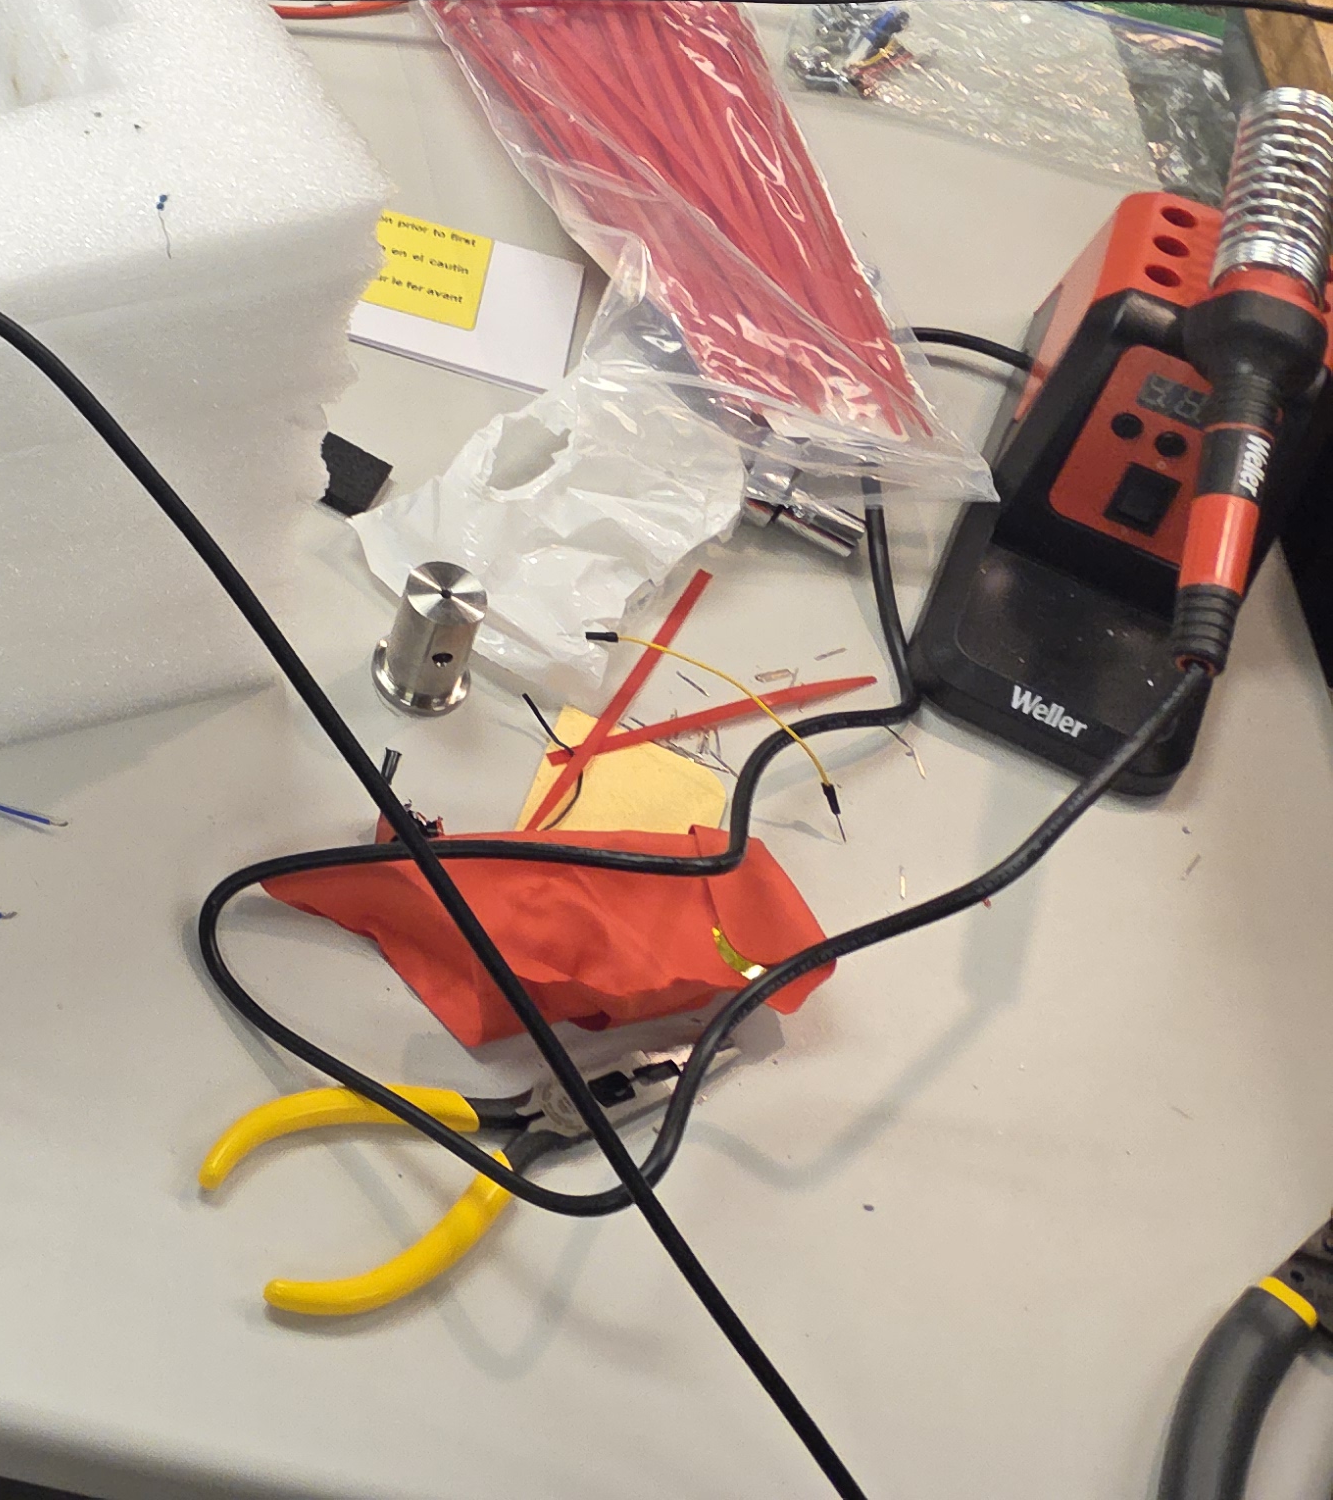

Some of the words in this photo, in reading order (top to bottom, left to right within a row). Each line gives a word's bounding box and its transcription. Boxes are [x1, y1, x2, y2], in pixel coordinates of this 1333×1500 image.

[397, 219, 429, 234] prior
[432, 228, 446, 239] to
[450, 232, 477, 247] first
[390, 247, 408, 258] en
[412, 252, 425, 263] el
[426, 286, 464, 304] avant
[1238, 433, 1272, 498] Weller
[1010, 685, 1088, 739] Weller
